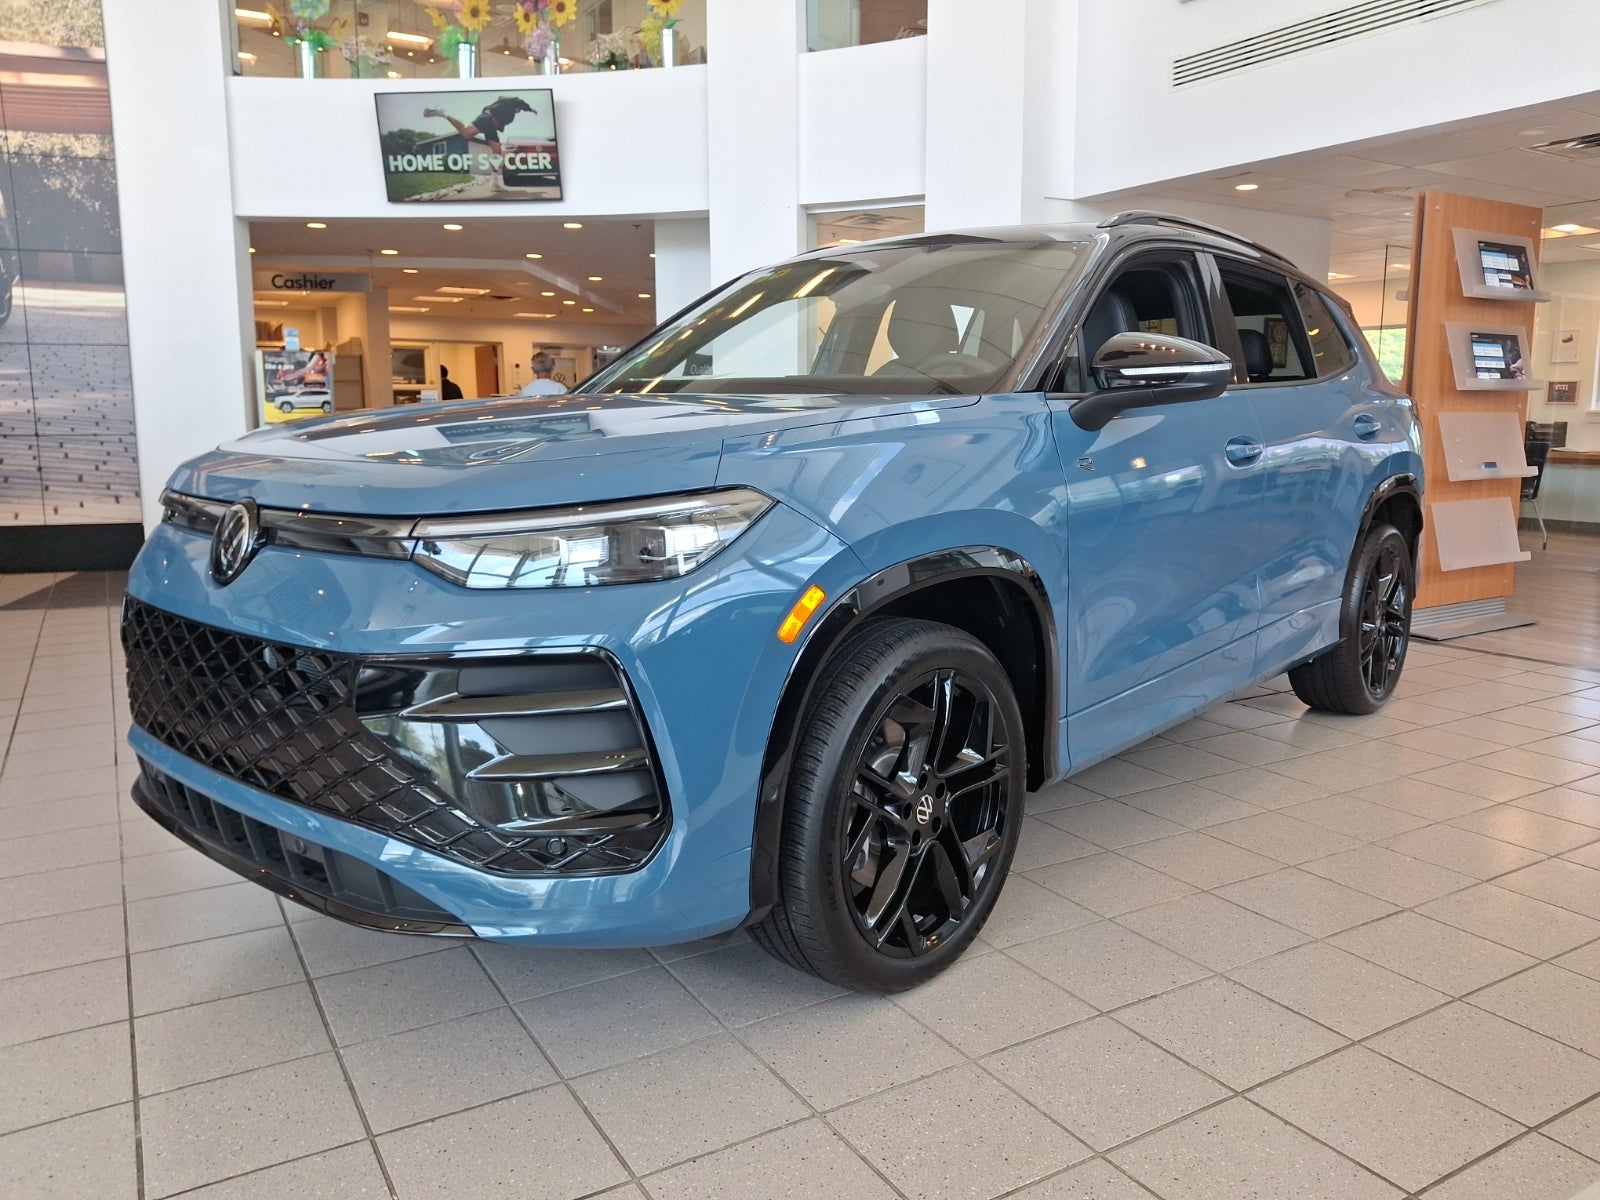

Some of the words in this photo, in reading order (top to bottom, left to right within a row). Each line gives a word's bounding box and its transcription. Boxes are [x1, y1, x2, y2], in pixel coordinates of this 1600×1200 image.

[388, 154, 444, 172] HOME
[447, 153, 473, 171] OF
[271, 274, 336, 289] Cashier
